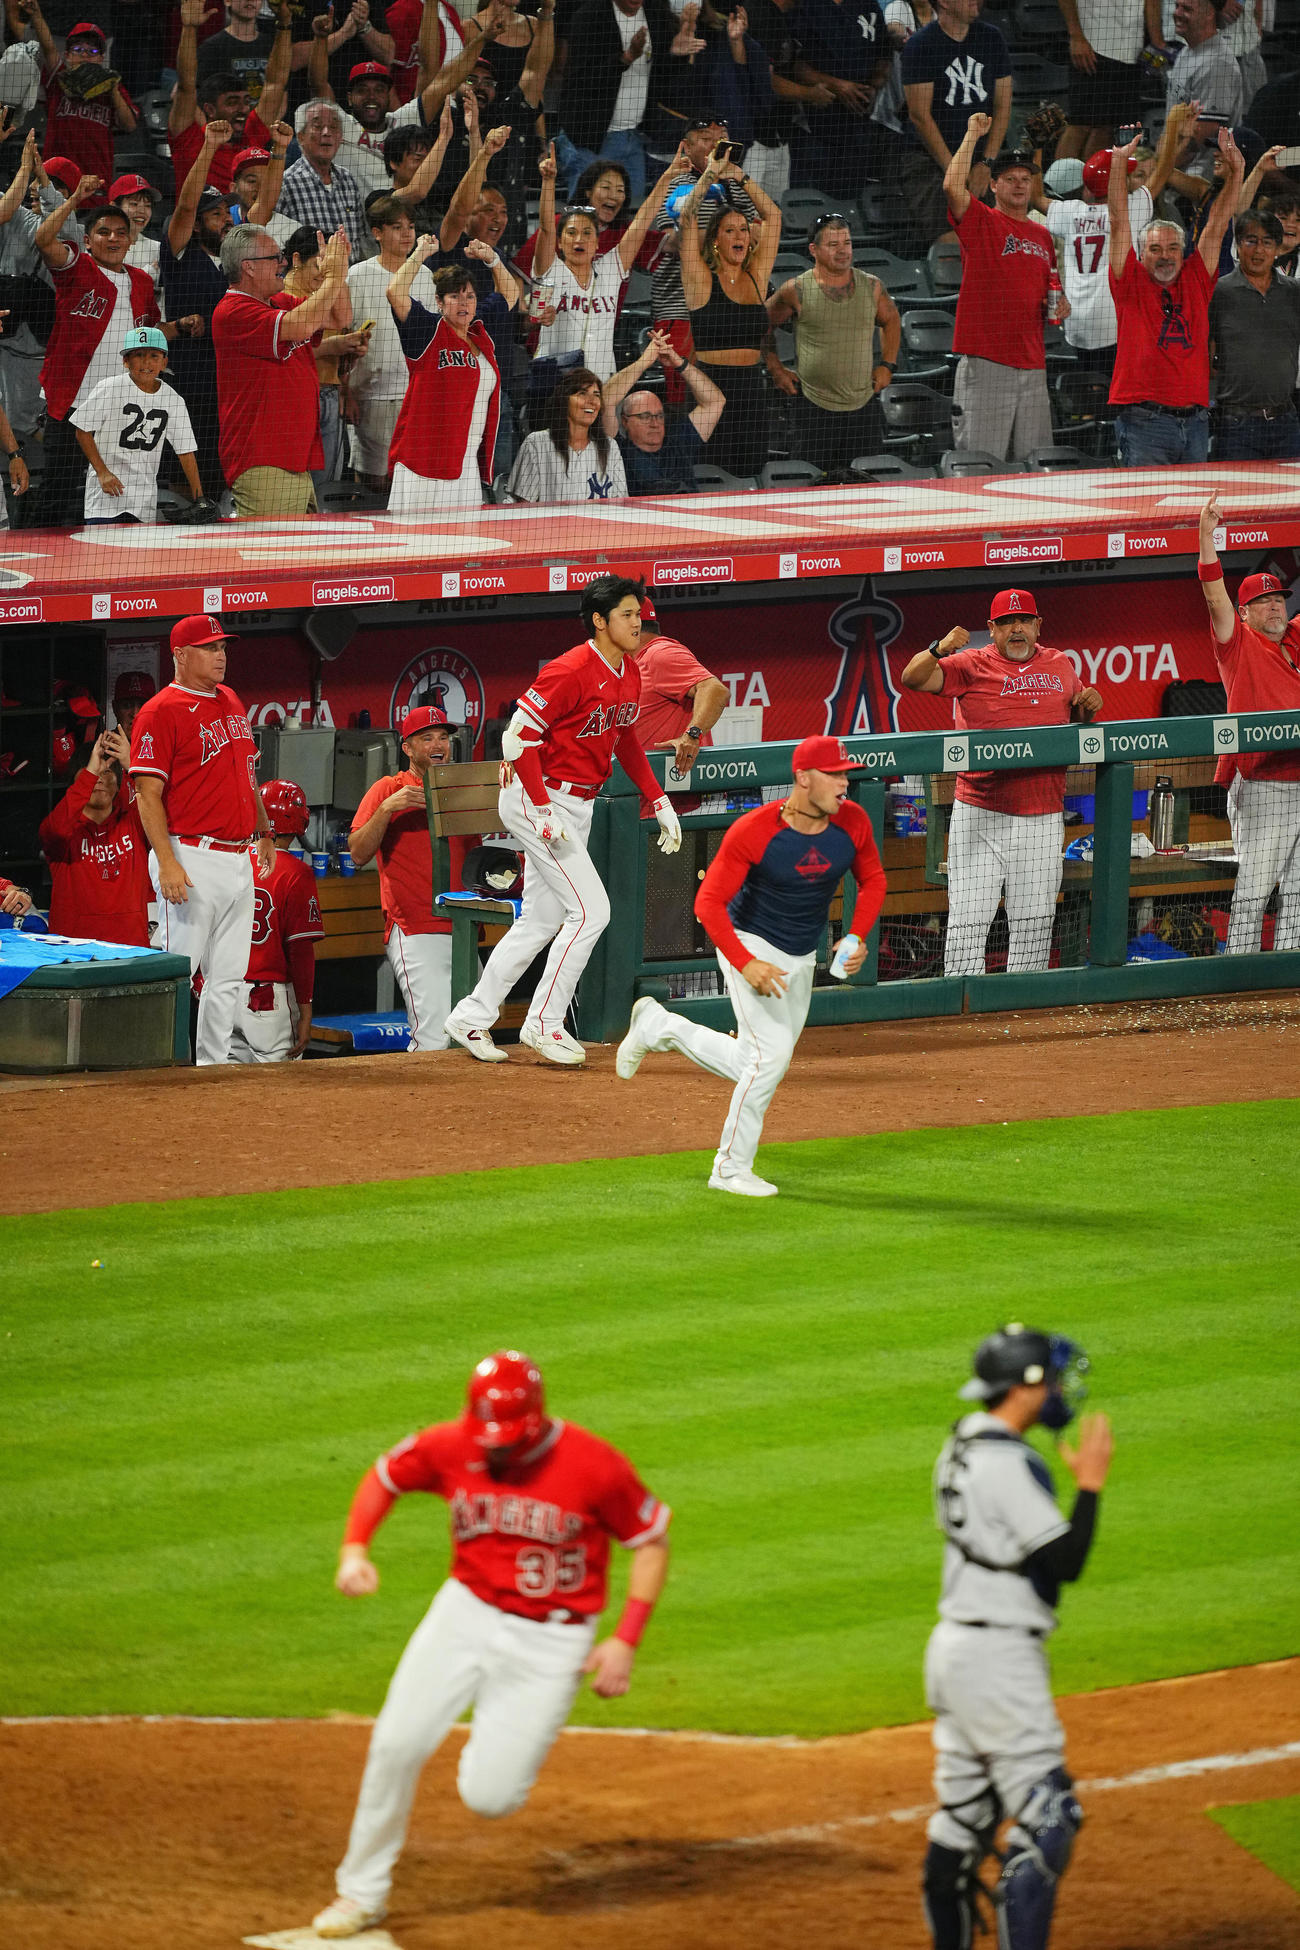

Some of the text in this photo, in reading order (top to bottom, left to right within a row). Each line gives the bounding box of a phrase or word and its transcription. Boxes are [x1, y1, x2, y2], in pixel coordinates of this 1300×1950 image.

[944, 55, 988, 106] NY
[1072, 234, 1106, 274] 17
[138, 331, 149, 344] a
[119, 403, 169, 452] 23
[587, 472, 614, 499] NY
[69, 462, 1300, 560] GELS
[1128, 537, 1168, 550] TOYOTA
[1230, 531, 1269, 544] TOYOTA
[904, 551, 945, 564] TOYOTA
[988, 543, 1059, 560] angels.com
[657, 564, 729, 581] angels.com
[800, 557, 842, 571] TOYOTA
[316, 583, 391, 601] angels.com
[463, 576, 506, 590] TOYOTA
[115, 598, 158, 612] TOYOTA
[226, 591, 268, 605] TOYOTA
[1009, 592, 1021, 610] A
[208, 616, 222, 634] A
[405, 652, 469, 692] ANGELS
[1072, 643, 1180, 684] OYOTA
[1000, 674, 1064, 697] ANGELS
[395, 706, 410, 723] 19
[426, 707, 441, 724] A
[464, 700, 478, 717] 61
[136, 732, 154, 760] A
[200, 713, 256, 767] ANGE
[1109, 733, 1169, 752] TOYOTA
[846, 751, 897, 768] OYOTA
[974, 742, 1034, 760] TOYOTA
[697, 761, 758, 780] TOYOTA
[308, 896, 321, 923] A
[514, 1545, 587, 1599] 35
